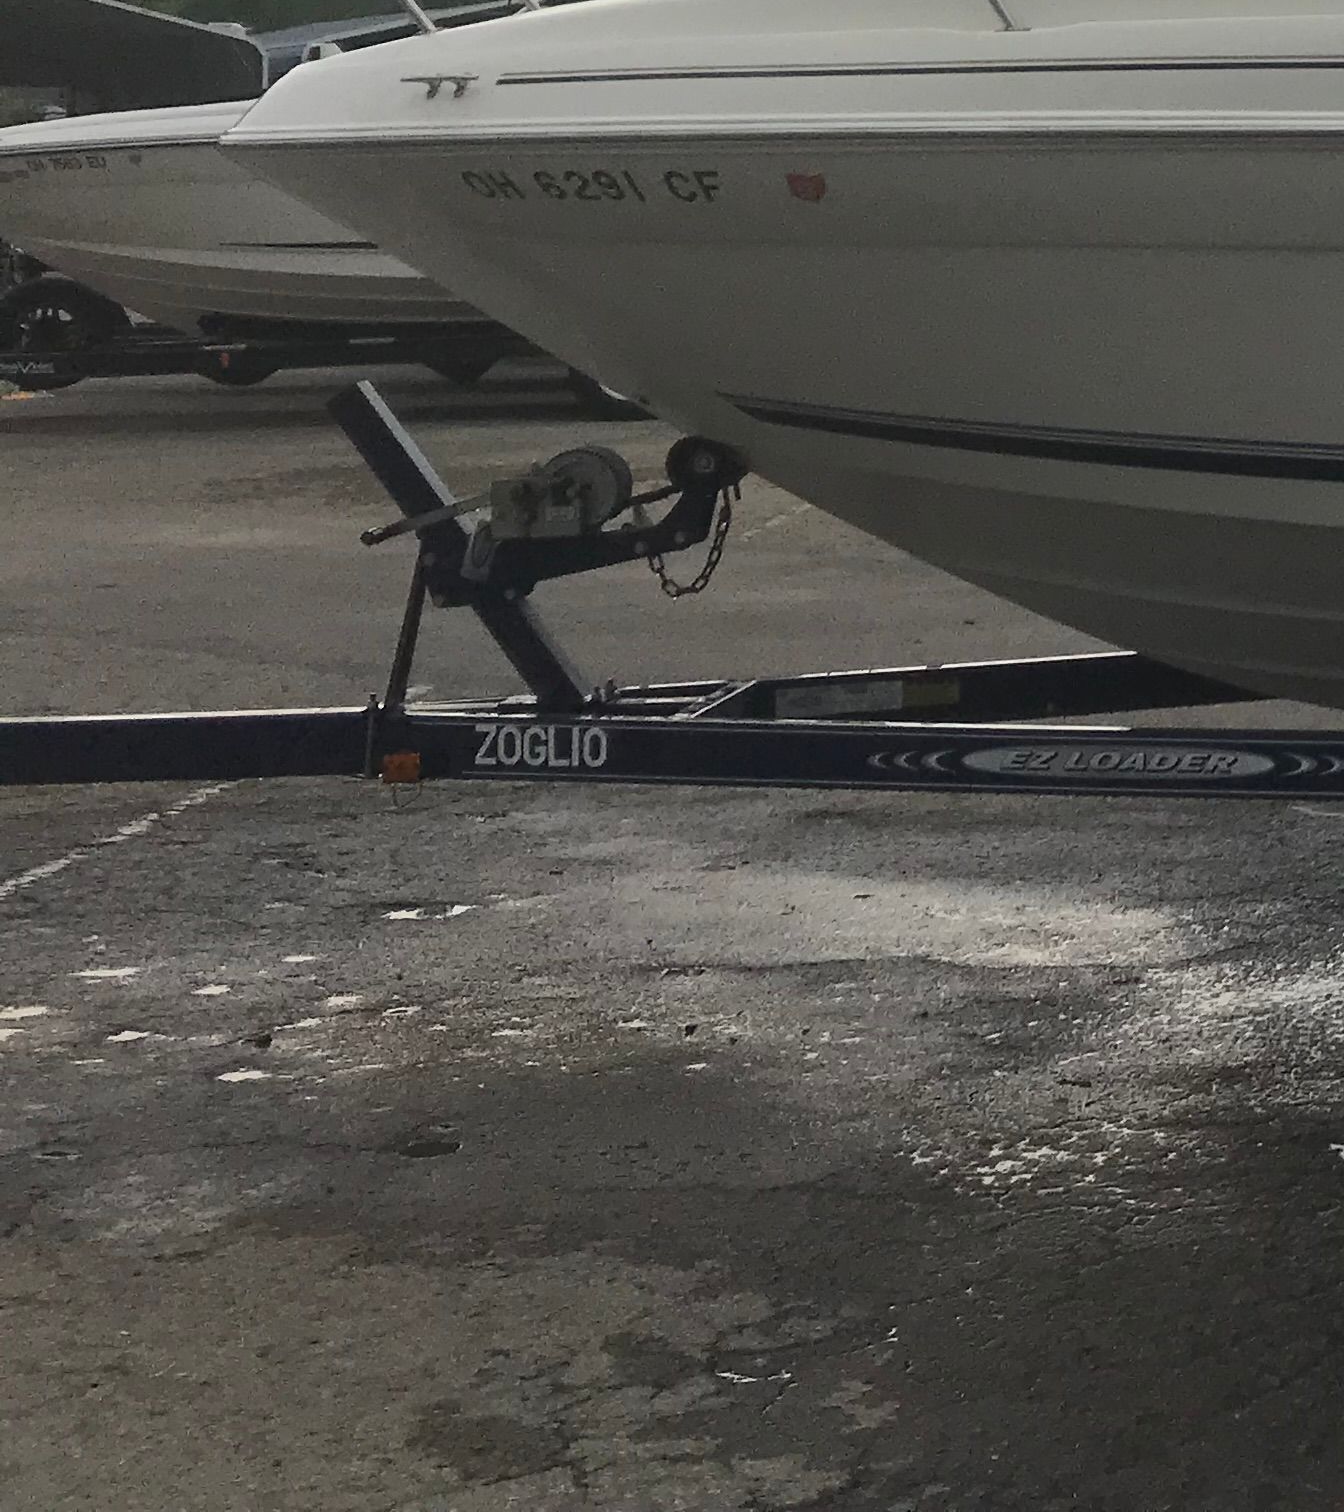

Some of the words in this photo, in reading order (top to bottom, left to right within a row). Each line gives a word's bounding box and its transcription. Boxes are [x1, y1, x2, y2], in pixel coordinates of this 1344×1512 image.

[461, 170, 527, 201] OH
[533, 170, 647, 203] 6291
[664, 170, 719, 203] CF
[475, 723, 608, 768] ZOGLIO
[1004, 750, 1058, 772] EZ
[1063, 750, 1239, 776] LOADER
